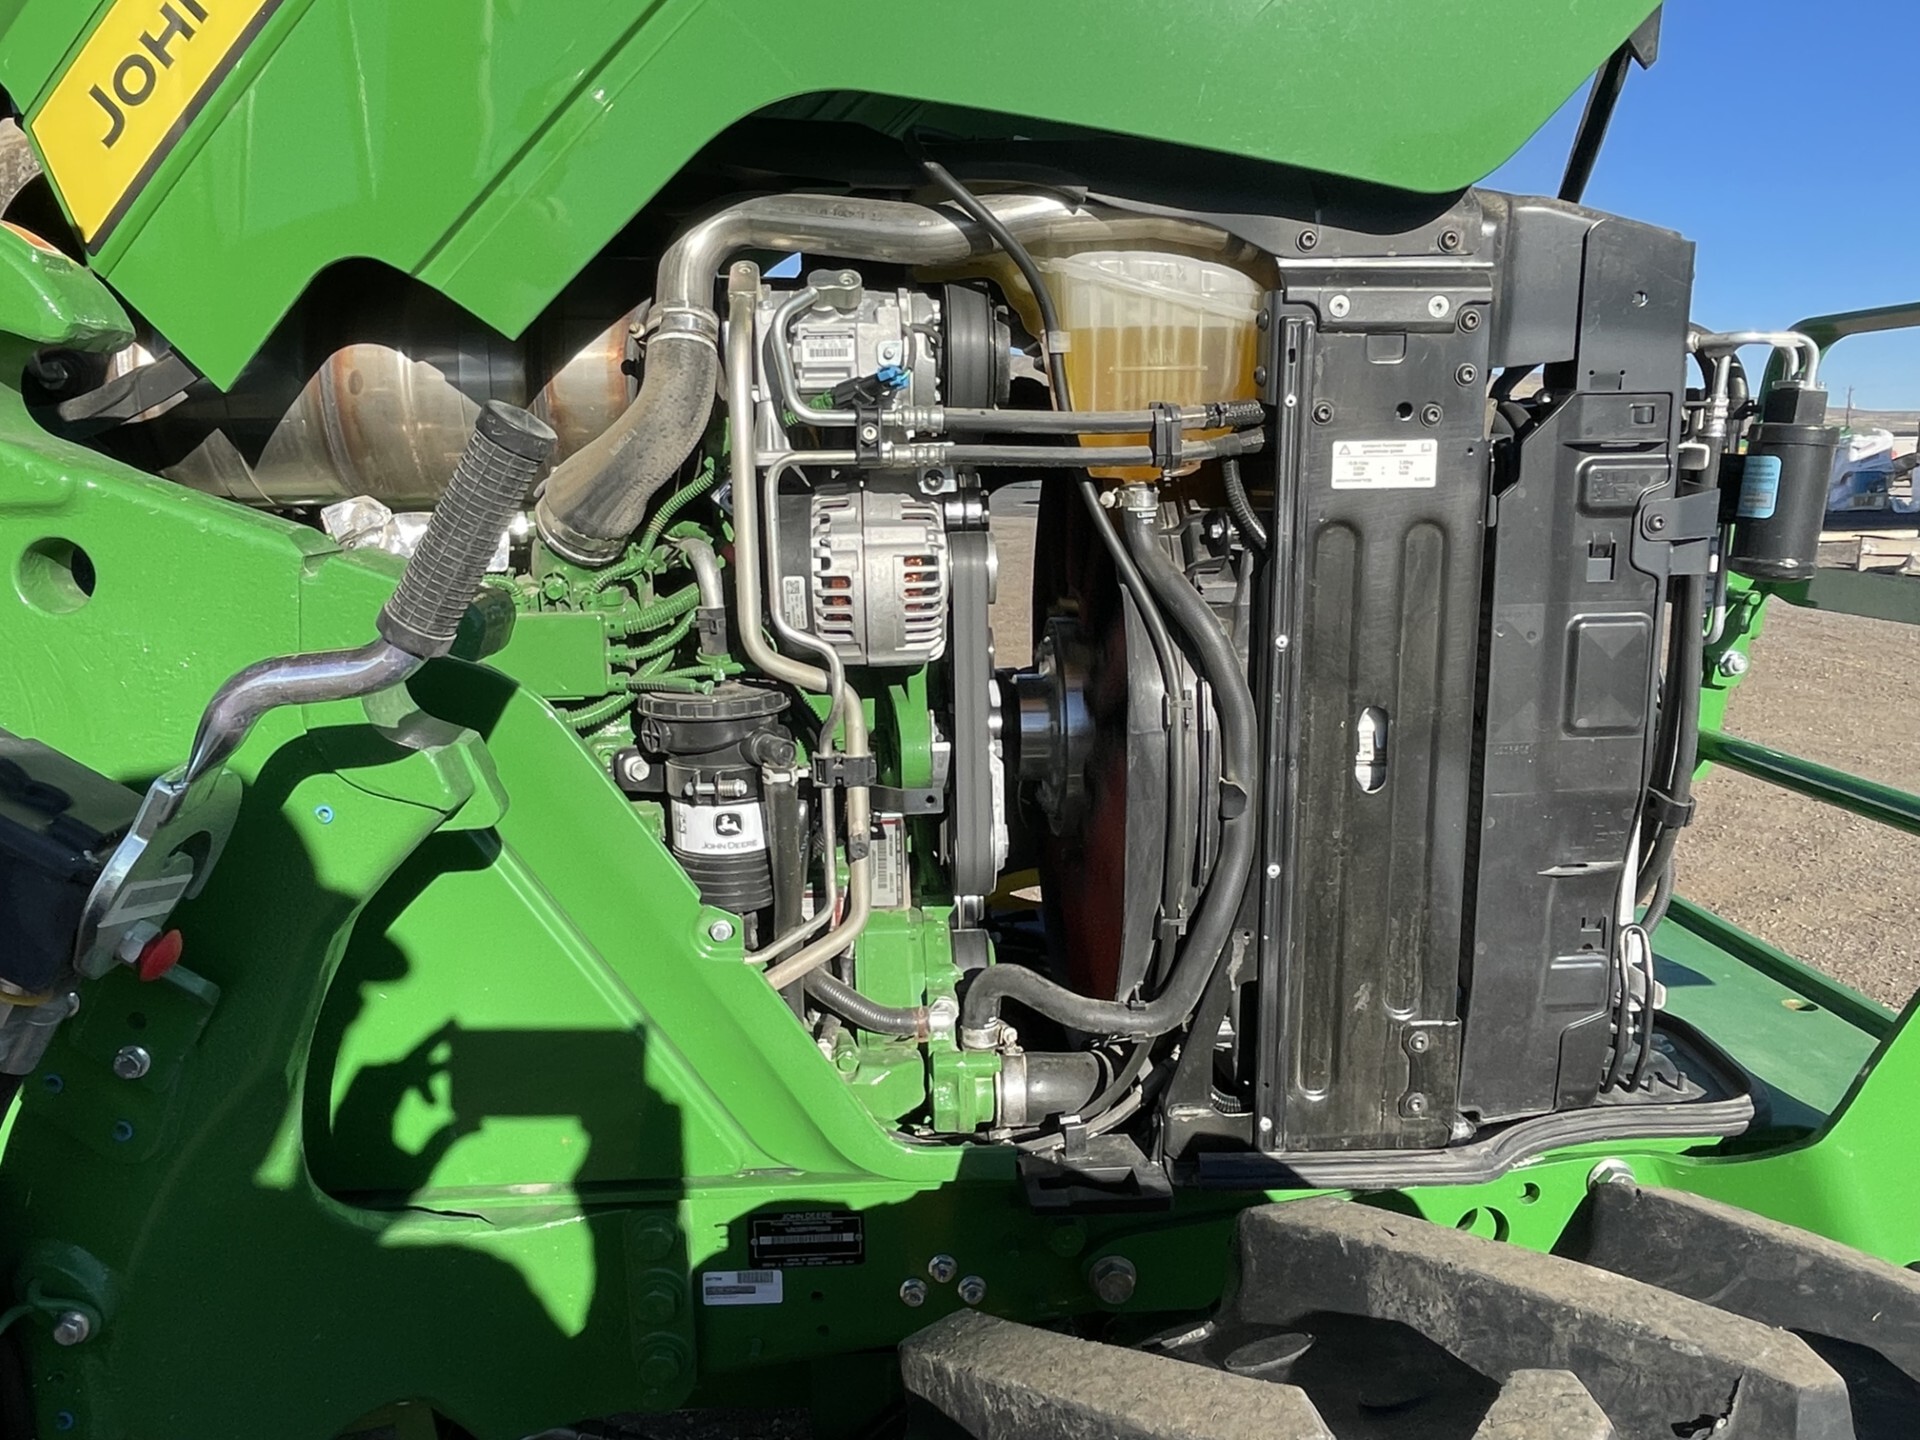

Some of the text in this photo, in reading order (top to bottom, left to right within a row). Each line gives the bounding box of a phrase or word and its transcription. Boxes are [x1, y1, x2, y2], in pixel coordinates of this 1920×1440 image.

[701, 839, 758, 850] JOHN DEERE
[781, 1213, 804, 1221] JOHN
